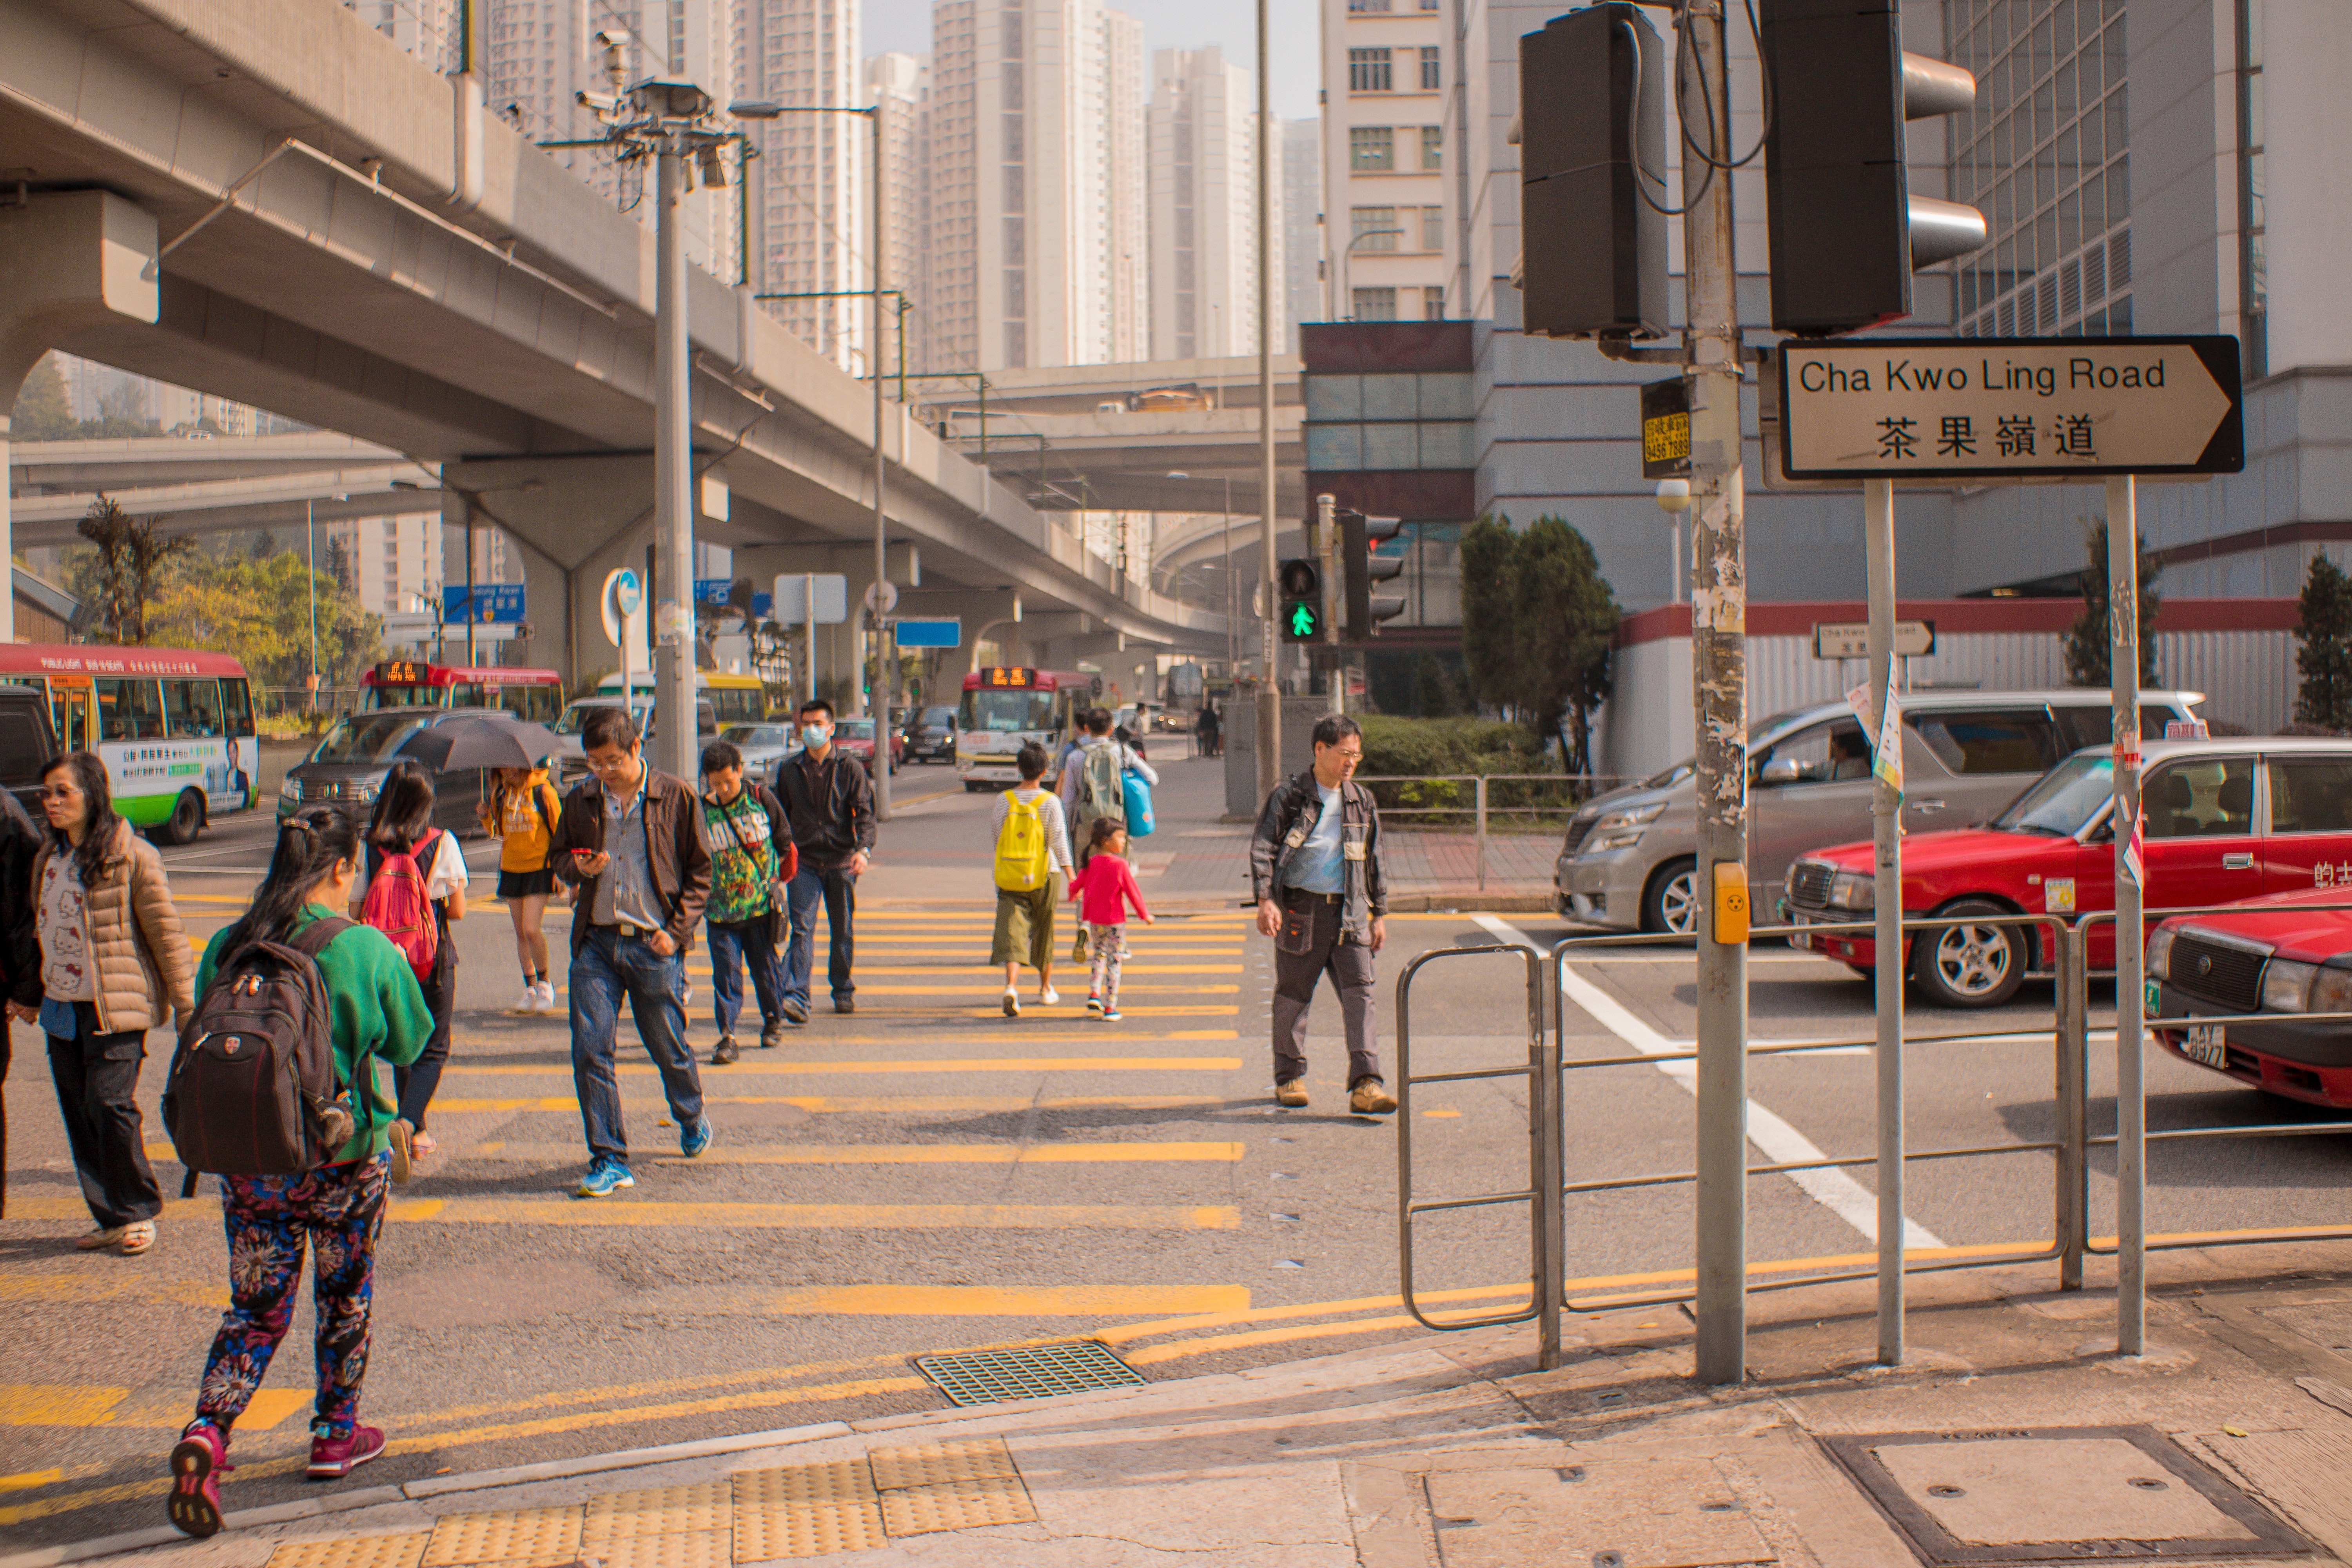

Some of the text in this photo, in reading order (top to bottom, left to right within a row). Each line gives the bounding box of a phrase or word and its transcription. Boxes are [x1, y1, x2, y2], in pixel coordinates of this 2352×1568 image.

[1800, 358, 2165, 397] Cha Kwo Ling Road
[1876, 414, 2096, 458] 茶果嶺道
[1646, 438, 1688, 461] 9456 7889
[1822, 628, 1841, 637] Cha
[1844, 628, 1866, 637] Kwo
[2167, 724, 2195, 738] TAXI
